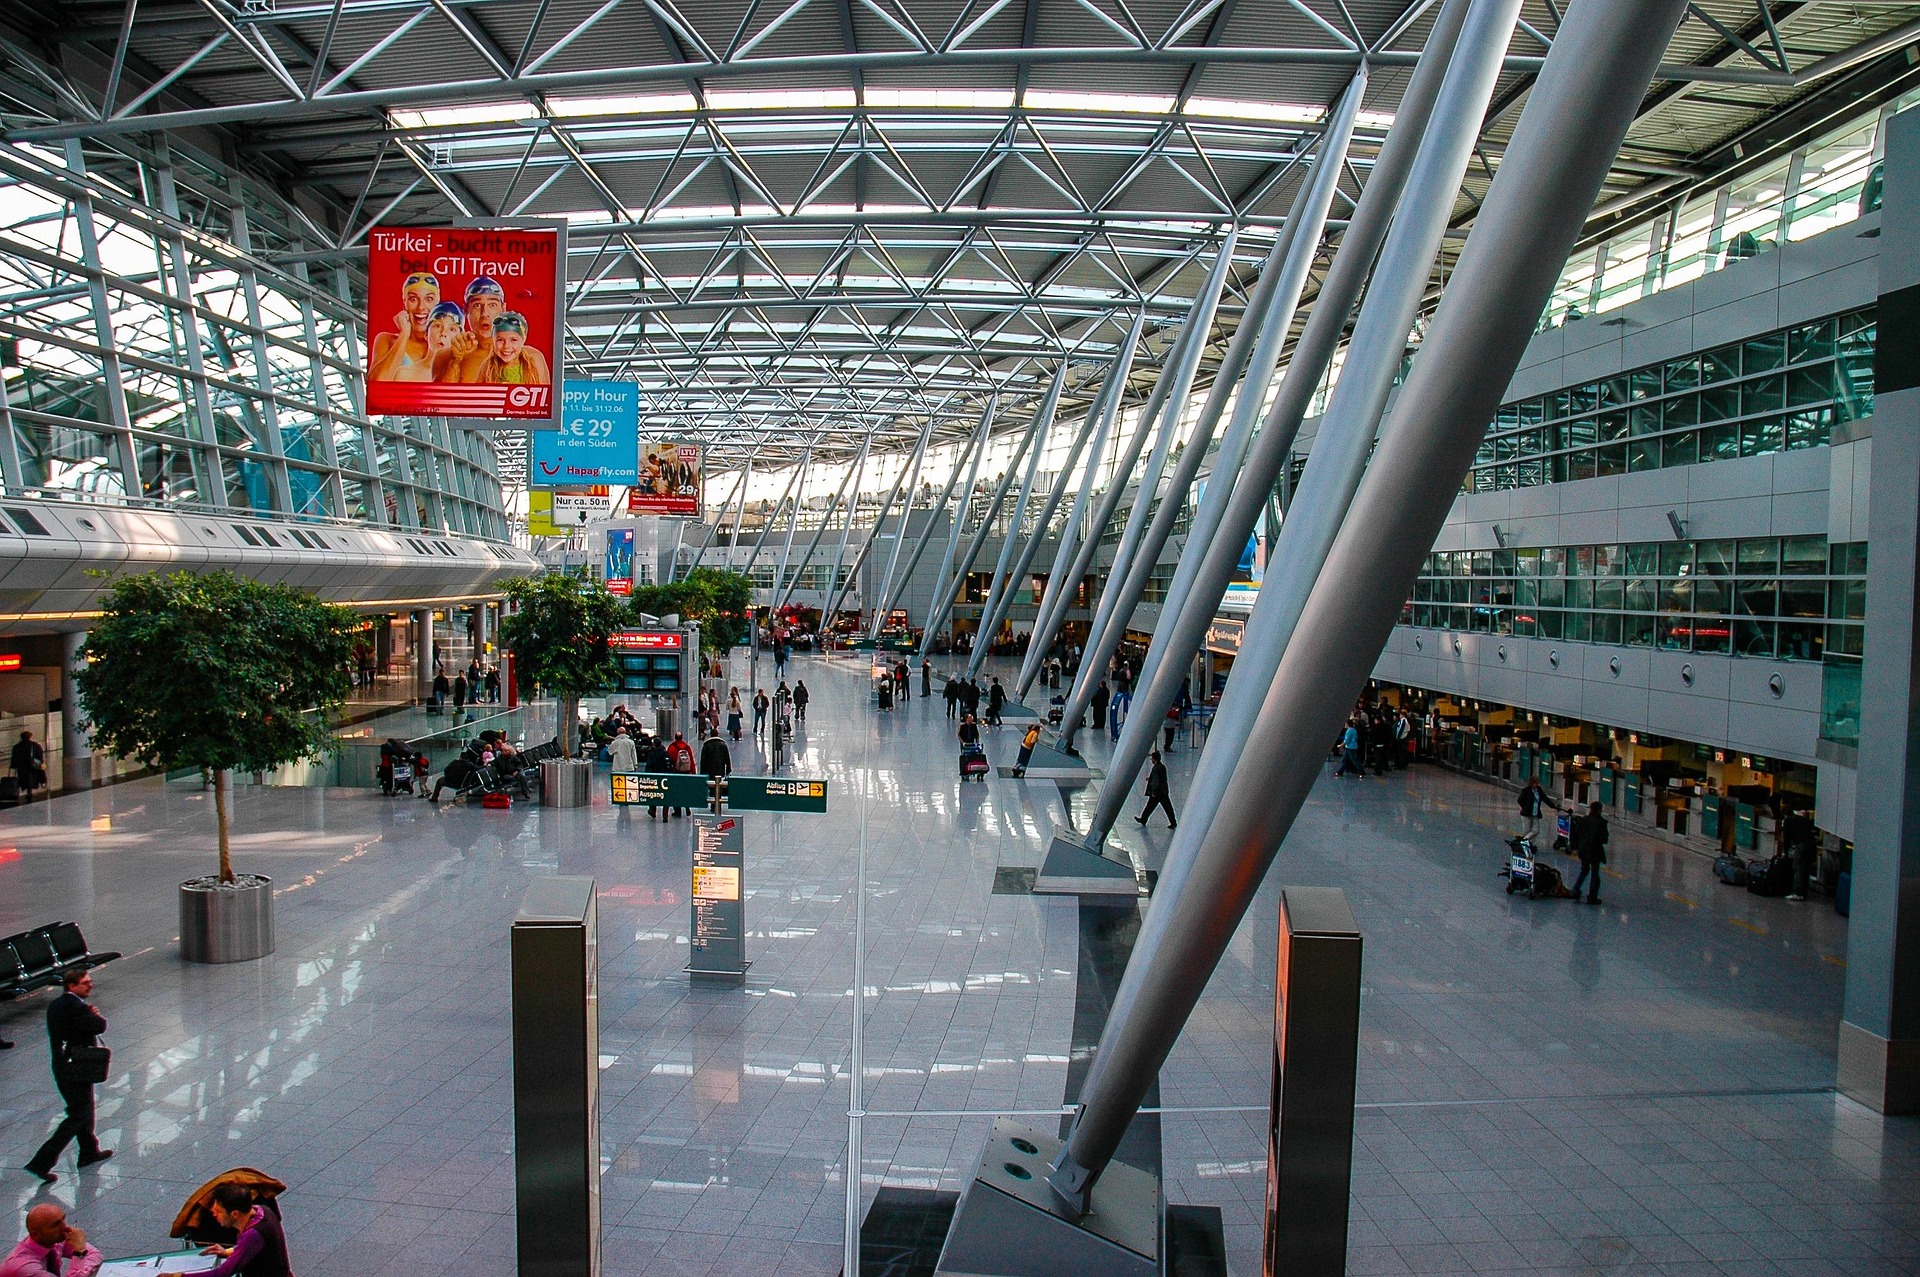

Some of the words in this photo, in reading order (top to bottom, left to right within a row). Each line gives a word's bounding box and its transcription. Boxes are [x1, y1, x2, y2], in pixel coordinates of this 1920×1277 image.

[374, 233, 431, 252] Türkei
[448, 235, 503, 253] bucht
[508, 240, 551, 255] man
[401, 257, 429, 273] bei
[433, 257, 465, 275] GTI
[469, 257, 525, 276] Travel
[509, 386, 548, 407] GTI
[563, 391, 590, 403] ppy
[594, 389, 627, 402] Hour
[595, 405, 623, 413] 31.12.06
[568, 438, 585, 447] den
[588, 438, 616, 447] Süden
[566, 466, 635, 477] Hapagfly.com
[556, 497, 571, 505] Nur
[639, 777, 657, 786] Abflug
[661, 778, 669, 790] C
[766, 782, 785, 791] Abflug
[788, 783, 796, 795] B
[639, 790, 664, 800] Ausgang
